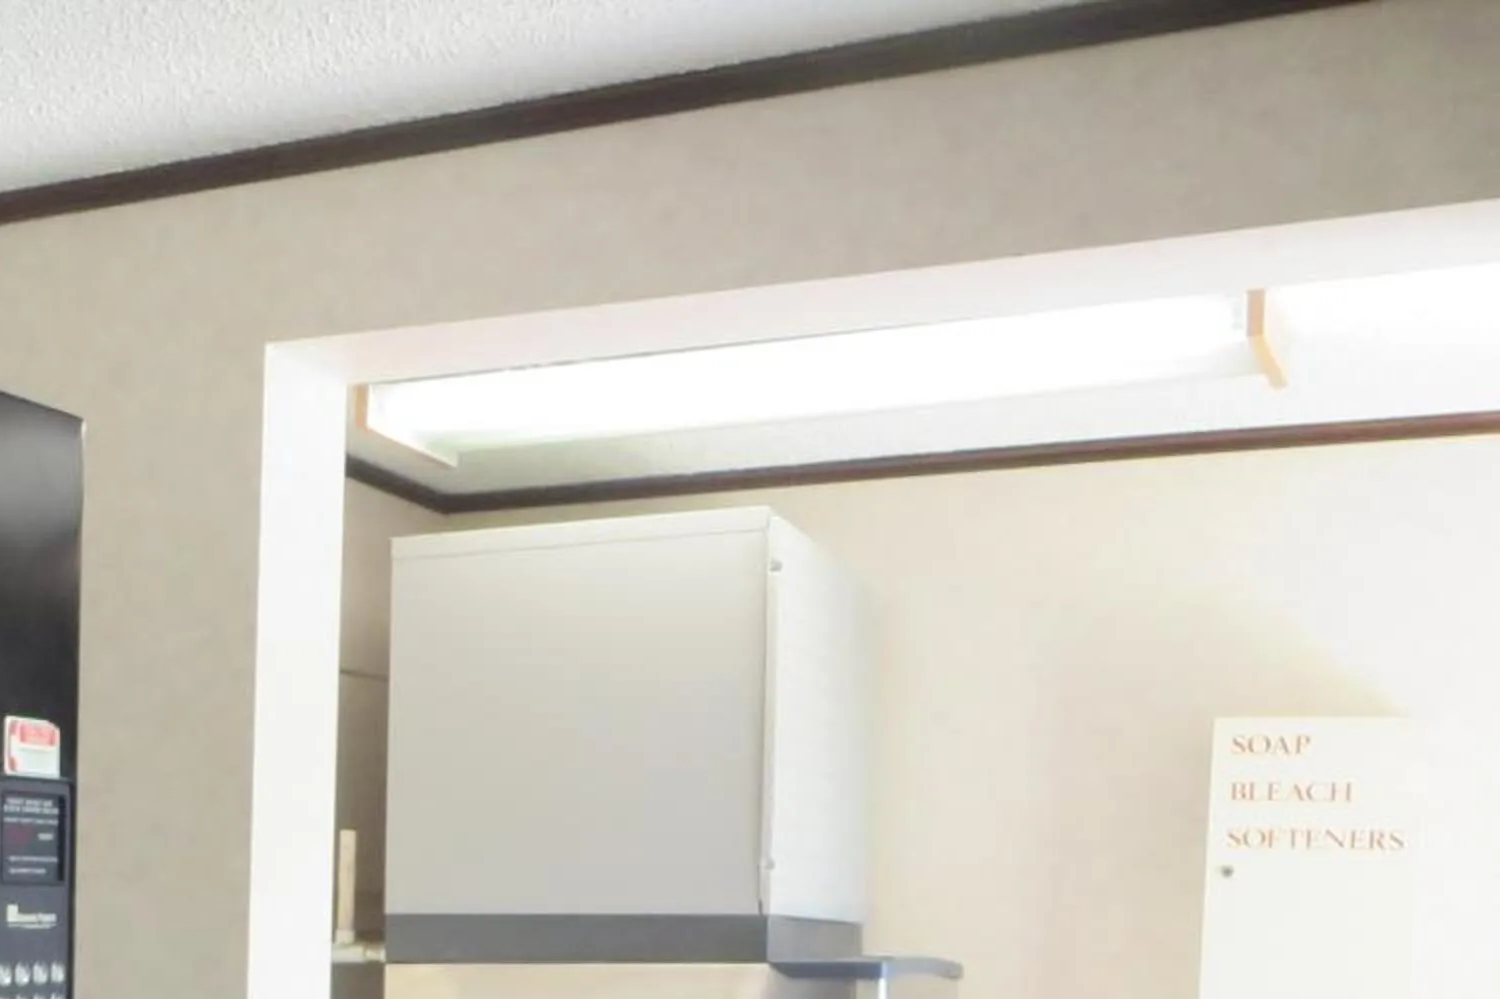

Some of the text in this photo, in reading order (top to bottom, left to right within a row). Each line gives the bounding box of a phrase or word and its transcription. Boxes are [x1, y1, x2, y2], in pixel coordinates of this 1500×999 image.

[1231, 733, 1311, 755] SOAP
[1231, 781, 1352, 802] BLEACH
[1227, 827, 1405, 850] SOFTENERS
